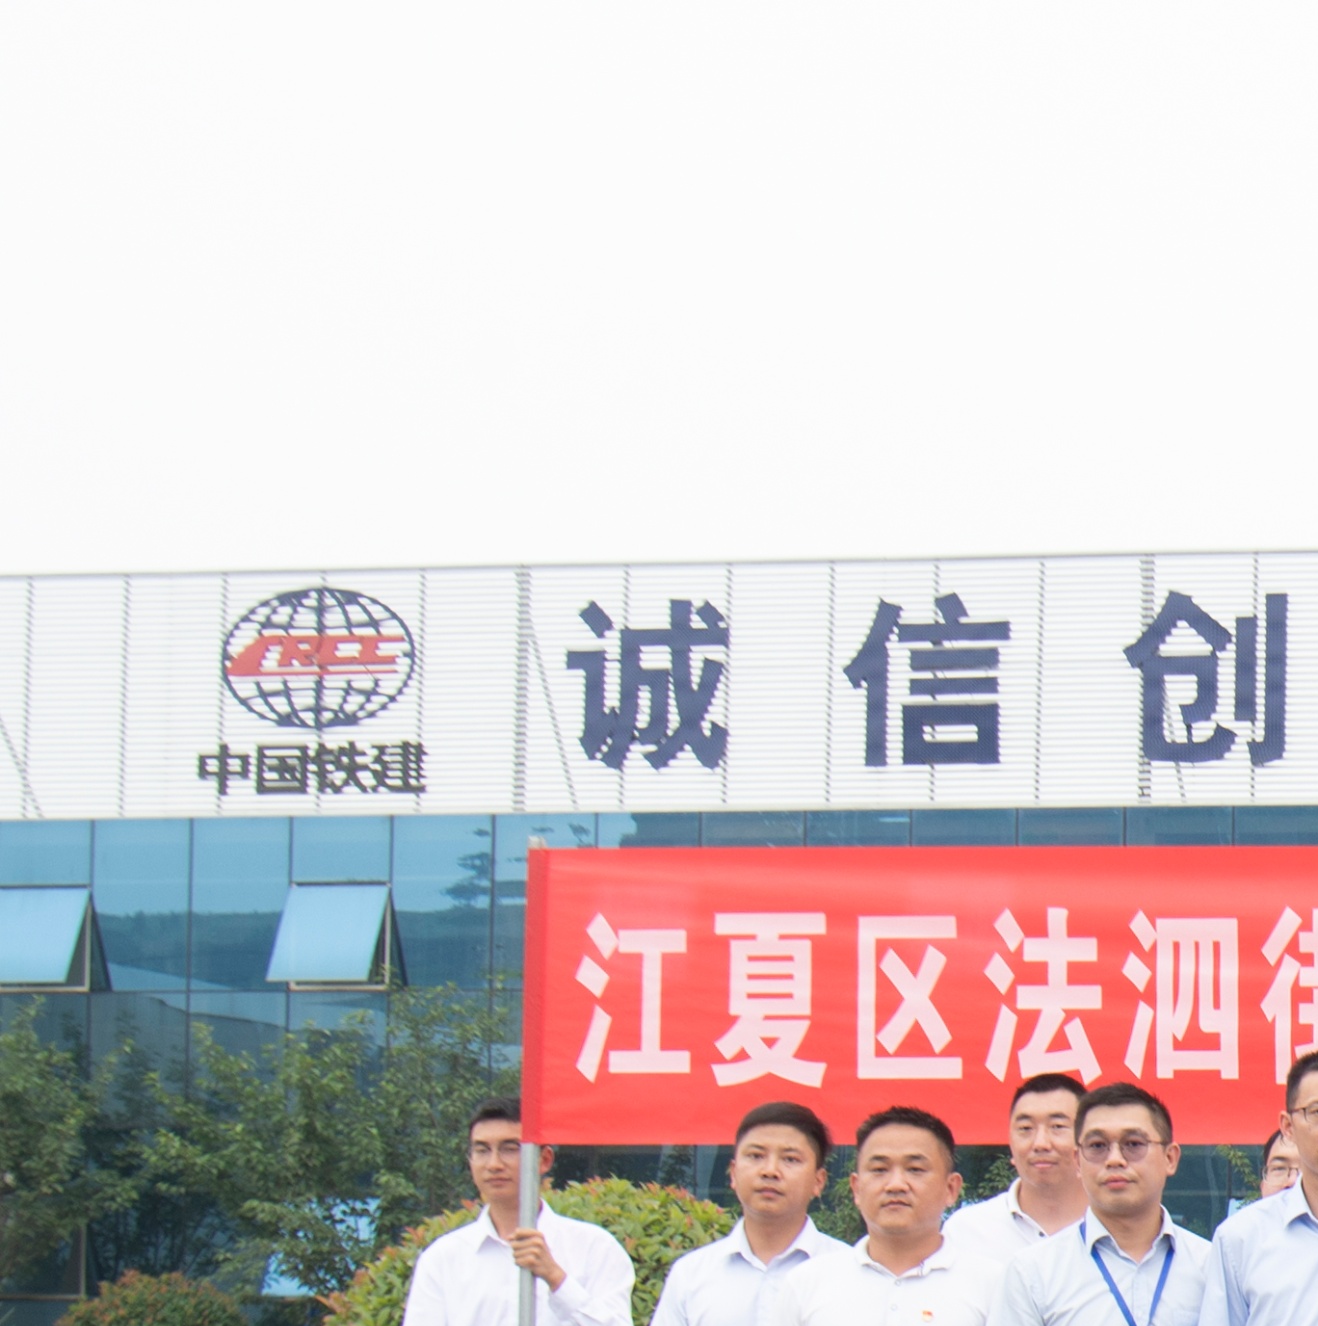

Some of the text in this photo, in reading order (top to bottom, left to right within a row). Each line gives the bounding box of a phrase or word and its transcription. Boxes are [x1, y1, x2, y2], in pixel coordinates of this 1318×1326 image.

[226, 634, 406, 677] CRCC
[198, 741, 428, 796] 中国铁建
